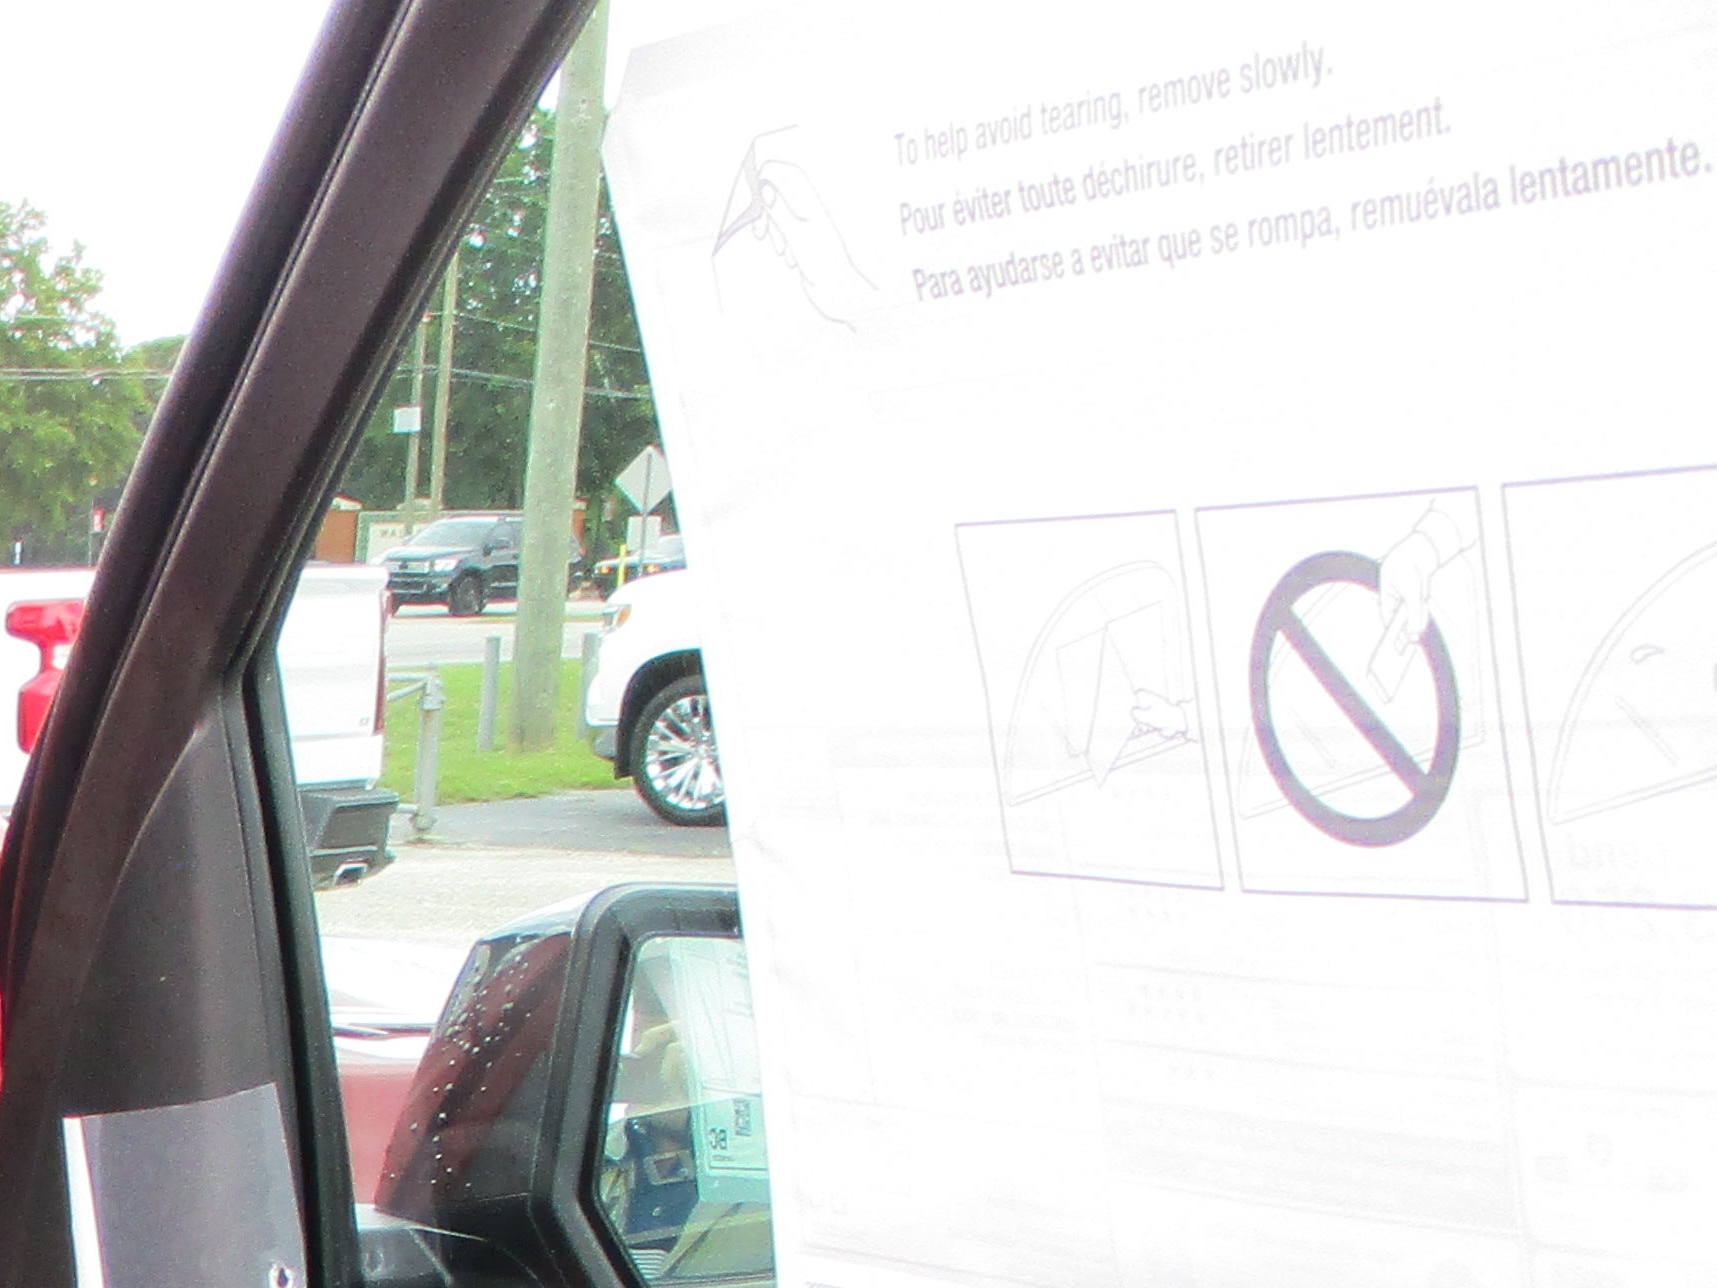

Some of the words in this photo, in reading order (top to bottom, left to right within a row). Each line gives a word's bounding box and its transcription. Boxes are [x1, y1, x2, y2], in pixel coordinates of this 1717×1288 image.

[893, 131, 918, 166] To
[925, 123, 968, 161] help
[975, 104, 1033, 150] avoid
[1039, 91, 1130, 135] tearing,
[1138, 68, 1231, 113] remove
[1240, 43, 1334, 94] slowly.
[899, 201, 945, 236] Pour
[952, 187, 1012, 226] éviter
[1017, 173, 1077, 213] toute
[1081, 153, 1206, 201] déchirure,
[1214, 132, 1295, 176] retirer
[1303, 97, 1451, 159] lentement.
[911, 266, 965, 302] Para
[966, 250, 1065, 296] ayudarse
[1070, 247, 1086, 277] a
[1089, 233, 1151, 274] evitar
[1157, 228, 1203, 268] que
[1210, 221, 1240, 255] se
[1248, 206, 1342, 248] rompa,
[1351, 173, 1501, 230] remuévala
[1509, 141, 1716, 205] lentamente.
